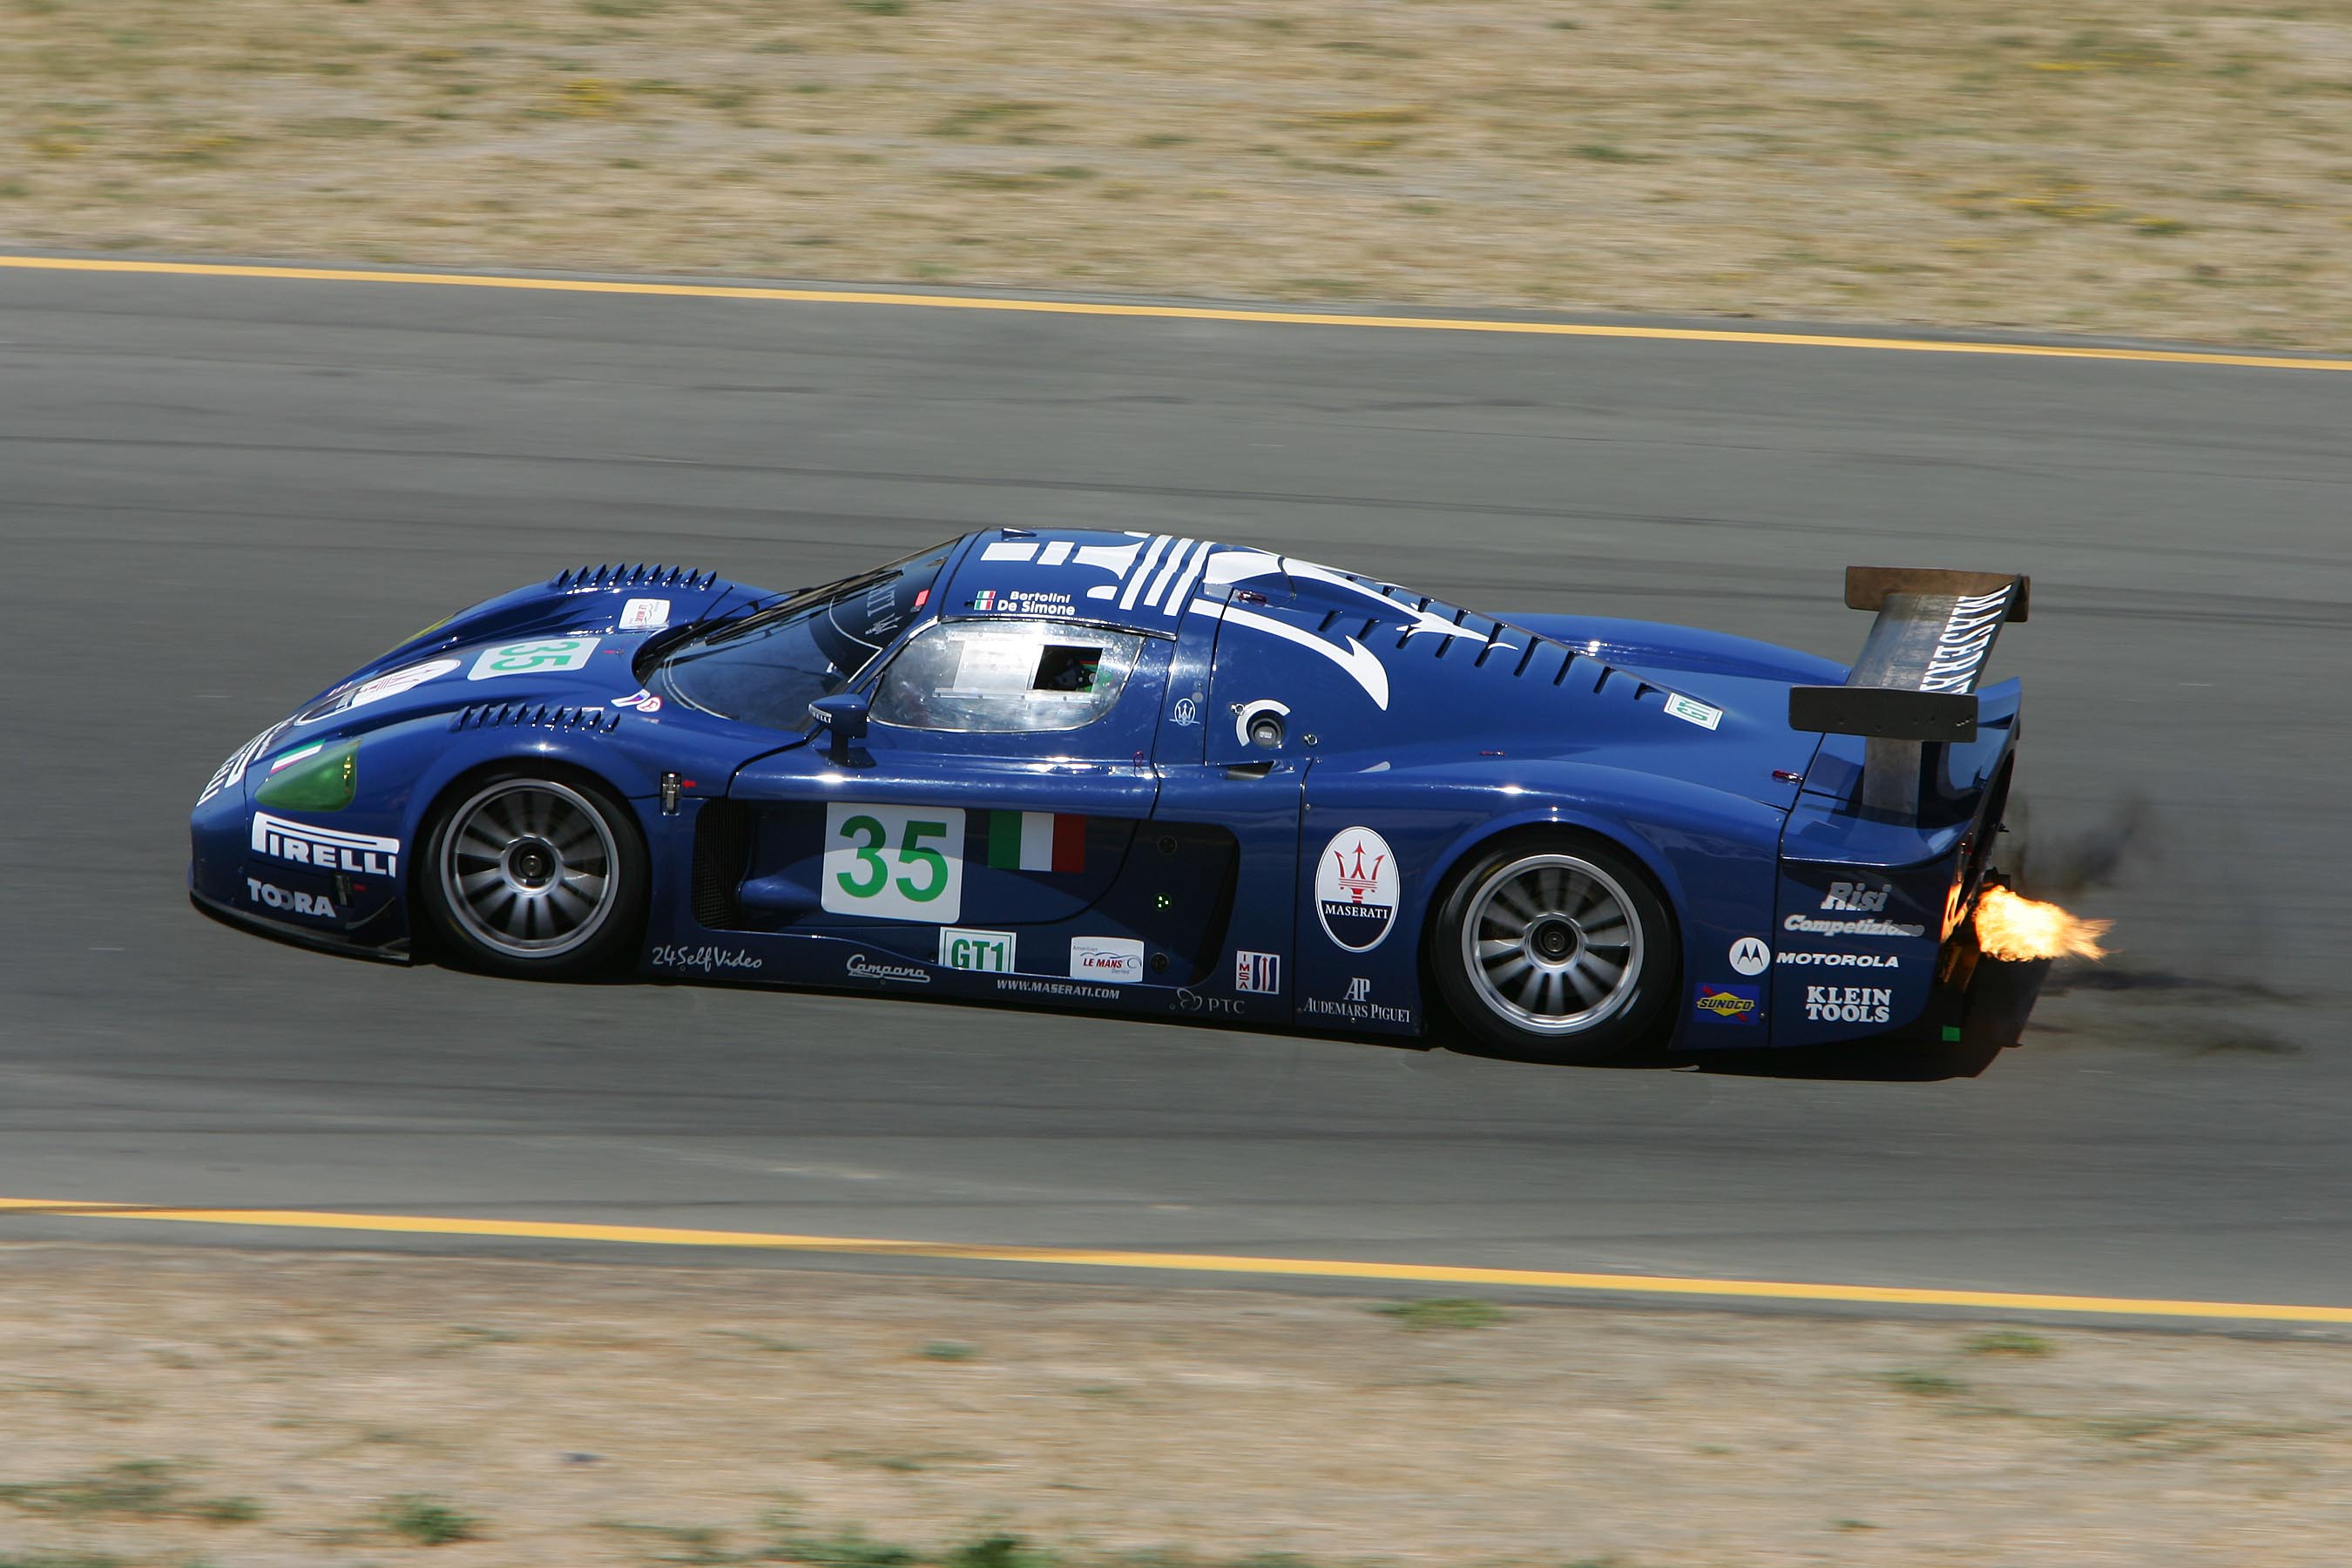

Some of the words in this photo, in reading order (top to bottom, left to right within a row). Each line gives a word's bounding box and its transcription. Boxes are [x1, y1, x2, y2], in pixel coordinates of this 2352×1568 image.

[997, 599, 1017, 612] De
[1021, 601, 1076, 615] Simone
[1010, 591, 1071, 604] Bertolini
[490, 642, 580, 671] 35
[252, 811, 400, 878] PIRELLI
[836, 815, 948, 911] 35
[247, 877, 336, 918] TOORA
[1821, 882, 1892, 911] Risi
[1325, 903, 1388, 919] MASERATI
[951, 938, 1004, 972] GT1
[1083, 958, 1094, 967] LE
[1096, 958, 1123, 969] MANS
[1777, 952, 1899, 968] MOTOROLA
[1239, 954, 1250, 990] IMSA
[997, 979, 1120, 999] WWW.MASERATI.COM
[1343, 977, 1370, 1002] AP
[1807, 986, 1892, 1006] KLEIN
[1207, 997, 1245, 1014] PTC
[1303, 997, 1369, 1018] AUDEMARS
[1370, 1004, 1410, 1023] PIGUET
[1699, 999, 1753, 1010] SUNOCO
[1805, 1004, 1890, 1023] TOOLS
